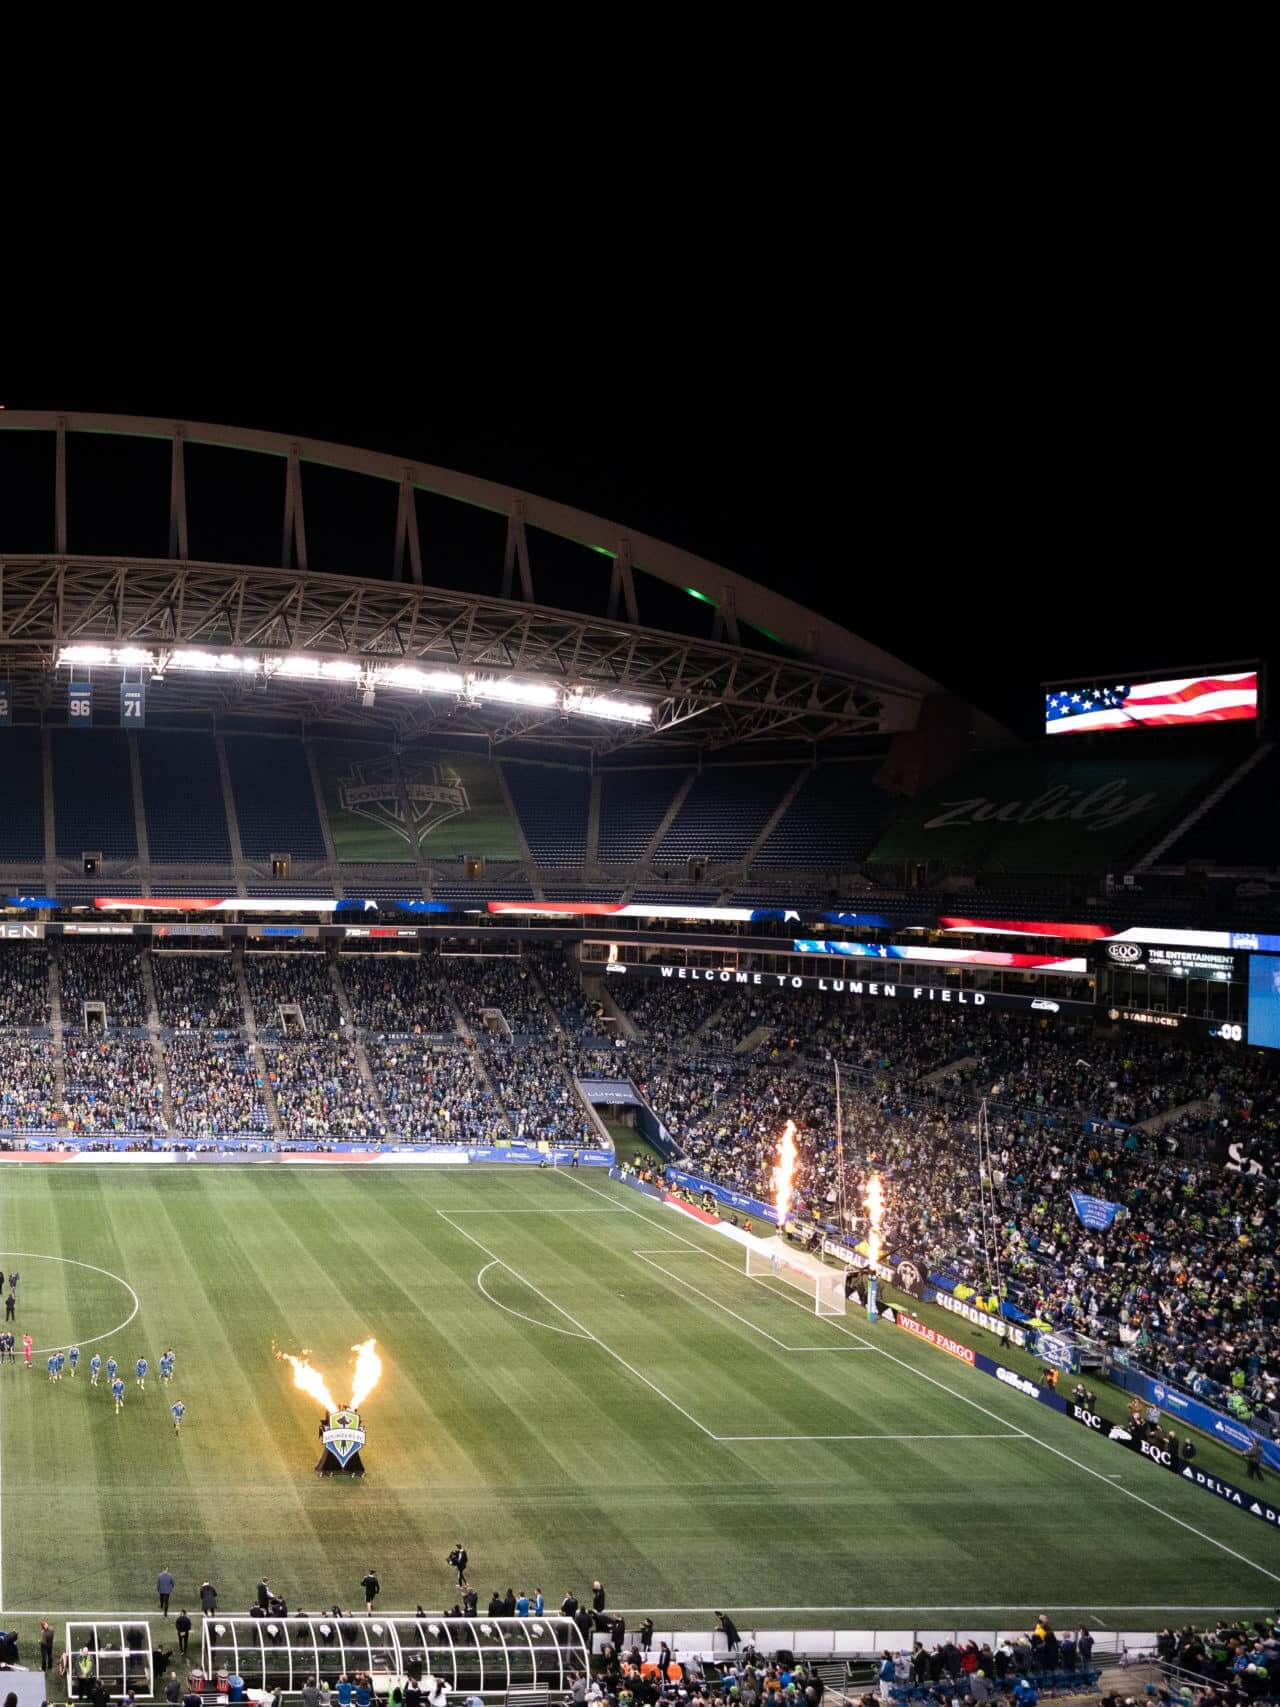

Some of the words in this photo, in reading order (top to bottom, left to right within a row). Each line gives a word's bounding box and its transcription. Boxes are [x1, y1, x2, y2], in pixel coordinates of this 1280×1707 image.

[70, 700, 91, 716] 96
[124, 700, 142, 717] 71
[923, 779, 1157, 831] zulily
[1108, 944, 1138, 958] EQC
[1148, 949, 1164, 958] THE
[1165, 950, 1235, 964] ENTERTAINMENT
[661, 967, 762, 985] WELCOME
[777, 975, 803, 988] TO
[819, 979, 896, 996] LUMEN
[914, 988, 986, 1005] FIELD
[1123, 1012, 1178, 1027] STARBUCKS
[824, 1239, 870, 1268] EMERAL
[899, 1313, 935, 1341] WELLS
[936, 1333, 974, 1361] FARGO
[996, 1366, 1040, 1398] Gillette
[1074, 1405, 1102, 1429] EQC
[1140, 1440, 1171, 1465] EQC
[1197, 1472, 1242, 1504] DELTA
